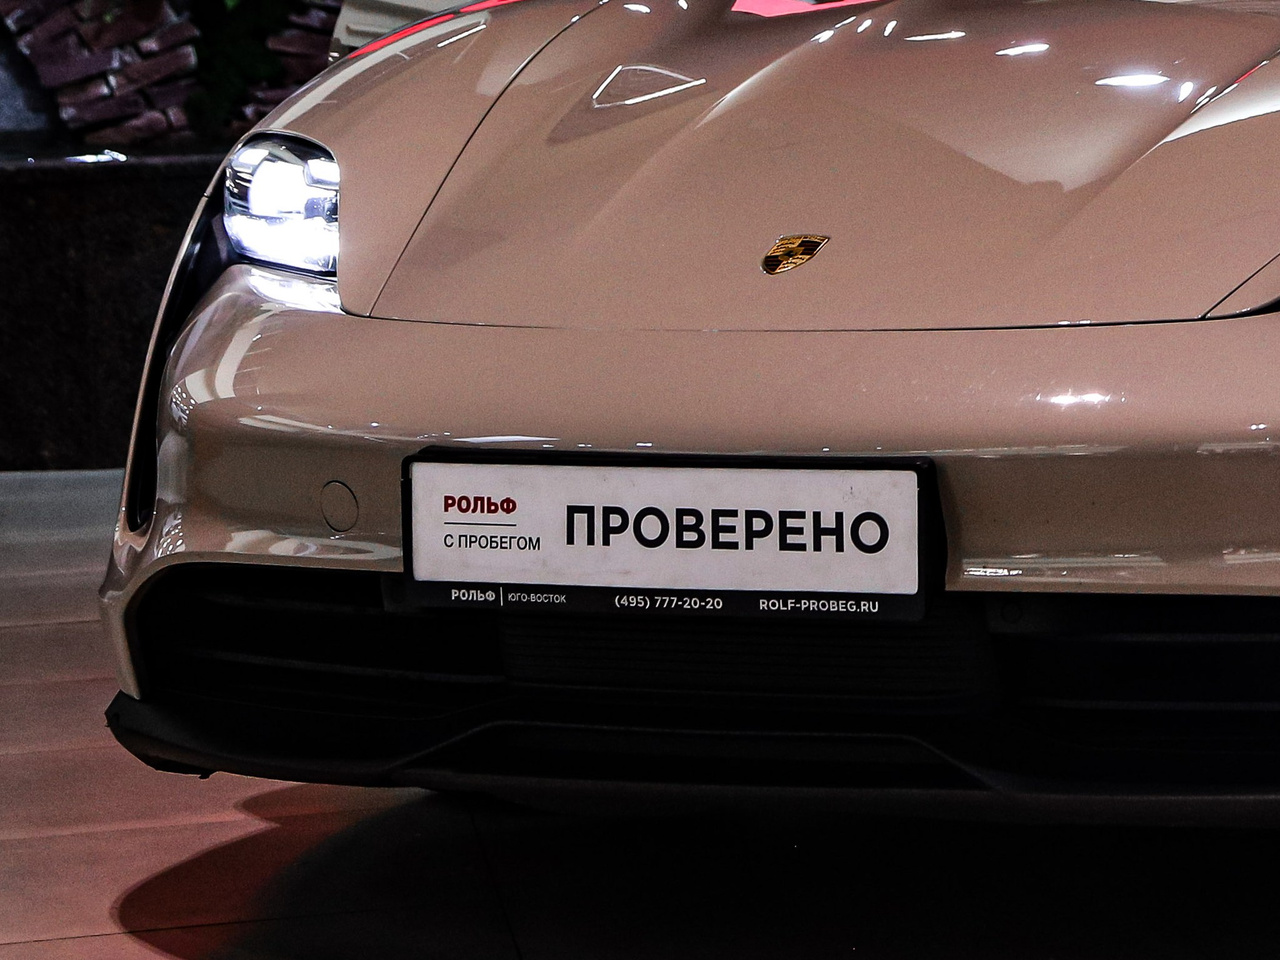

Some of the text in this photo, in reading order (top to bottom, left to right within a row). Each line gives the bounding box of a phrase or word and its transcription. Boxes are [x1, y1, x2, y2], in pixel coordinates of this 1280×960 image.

[443, 495, 517, 515] РОЛЬФ
[565, 504, 890, 555] ПРОВЕРЕНО
[443, 533, 541, 551] С ПРОБЕГОМ
[451, 589, 567, 604] РОЛЬФ ЮГО-ВОСТОК
[614, 595, 723, 610] (495) 777-20-20
[759, 598, 879, 613] ROLF-PROBEG.RU
